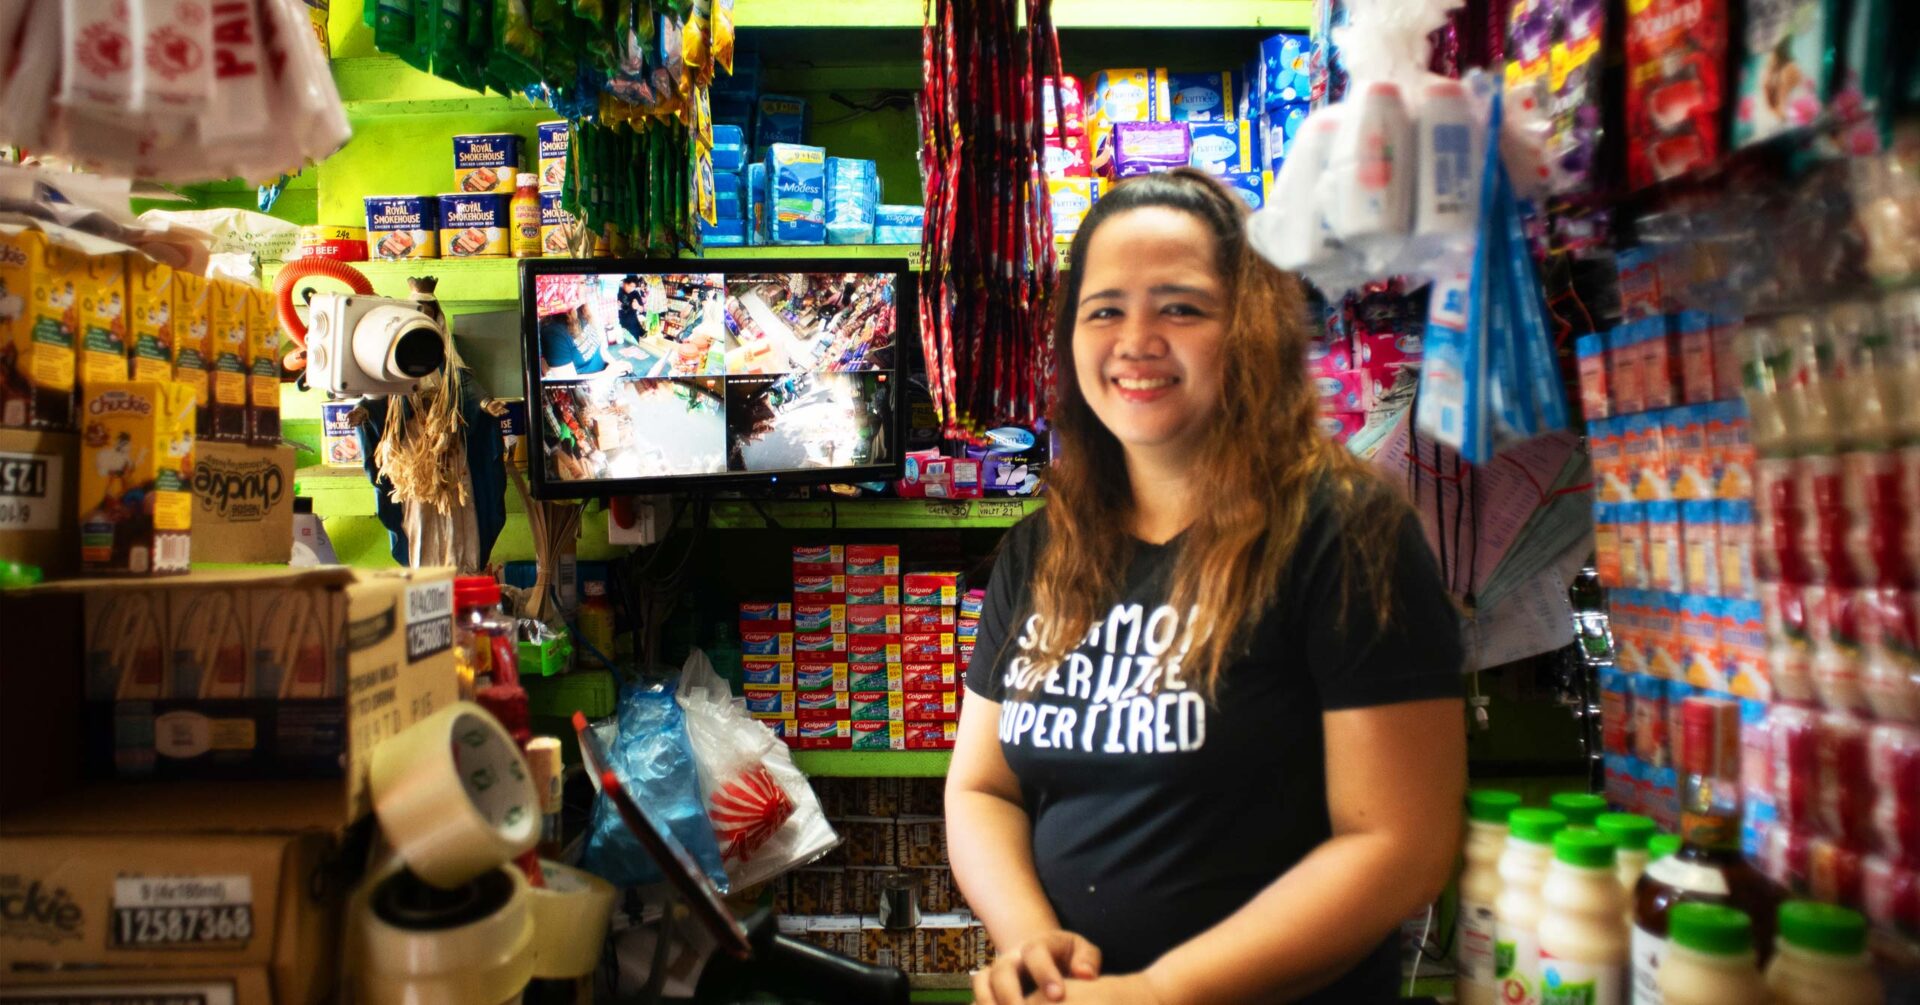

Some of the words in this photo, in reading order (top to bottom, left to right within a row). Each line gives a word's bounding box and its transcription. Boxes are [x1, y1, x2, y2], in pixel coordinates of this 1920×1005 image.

[471, 143, 493, 152] ROYAL
[459, 151, 505, 161] SMOKEHOUSE
[784, 182, 819, 194] Modess
[385, 206, 408, 215] ROYAL
[459, 202, 482, 212] ROYAL
[374, 214, 420, 224] SMOKEHOUSE
[448, 211, 495, 221] SMOKEHOUSE
[316, 246, 338, 255] BEEF
[952, 506, 967, 516] 30
[1002, 508, 1013, 517] 21
[745, 633, 770, 641] Colgate
[746, 662, 772, 670] Colgate
[748, 691, 774, 699] Colgate
[803, 693, 829, 701] Colgate
[1081, 691, 1206, 754] TIRED
[121, 908, 251, 943] 12587368
